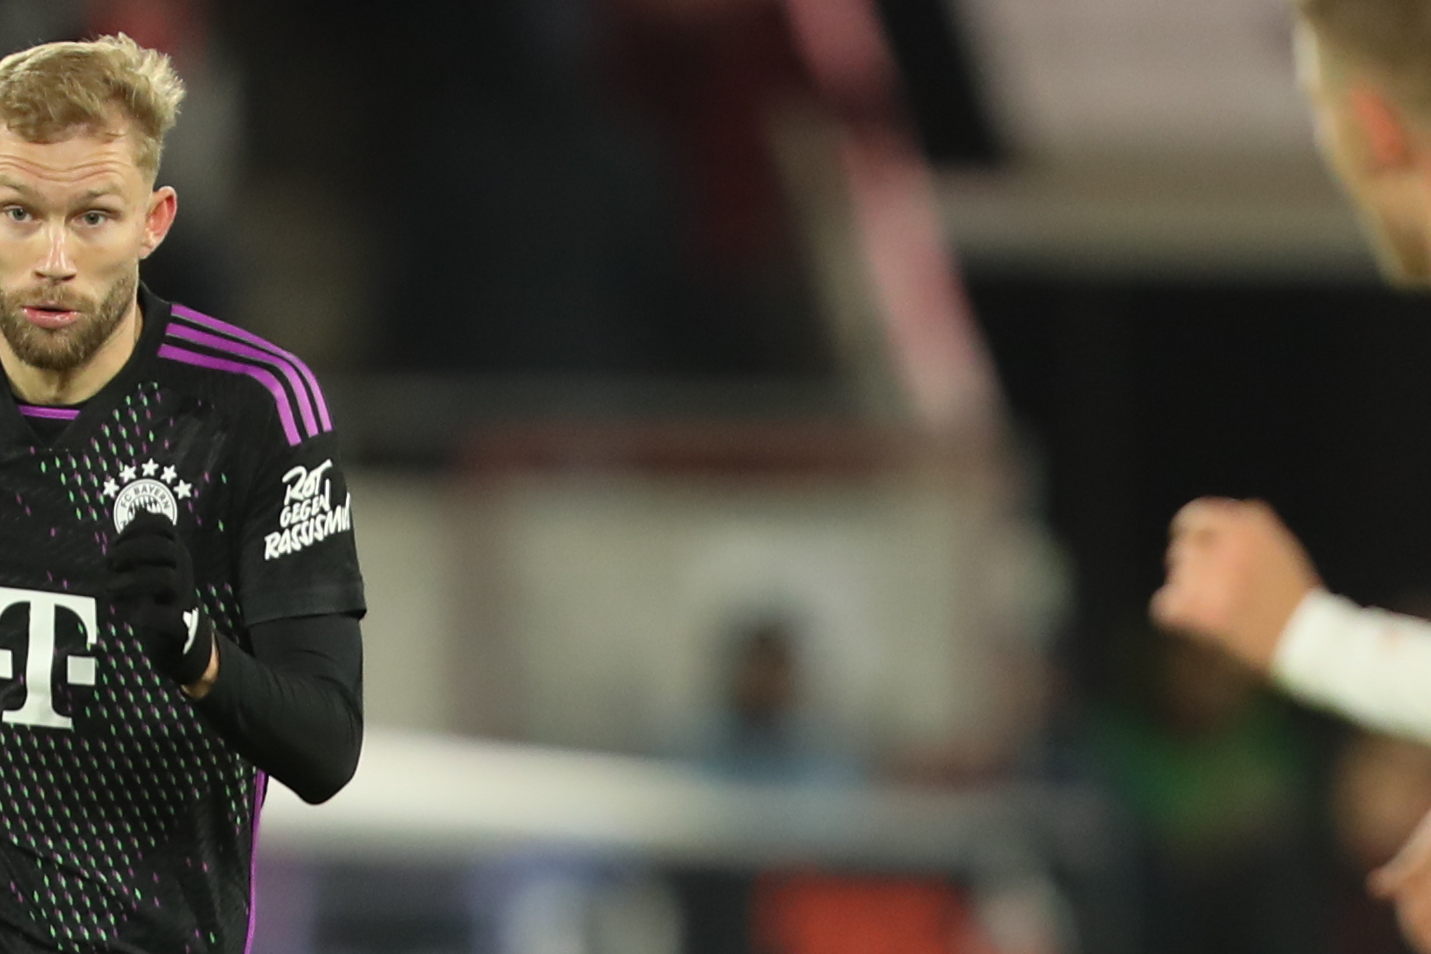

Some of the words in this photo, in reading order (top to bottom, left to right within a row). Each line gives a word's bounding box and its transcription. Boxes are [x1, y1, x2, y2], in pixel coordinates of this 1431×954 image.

[120, 493, 132, 508] FC
[133, 484, 171, 509] BAYERN
[280, 479, 330, 528] GEGEN
[282, 459, 332, 506] ROT
[264, 491, 351, 560] RASSISMU
